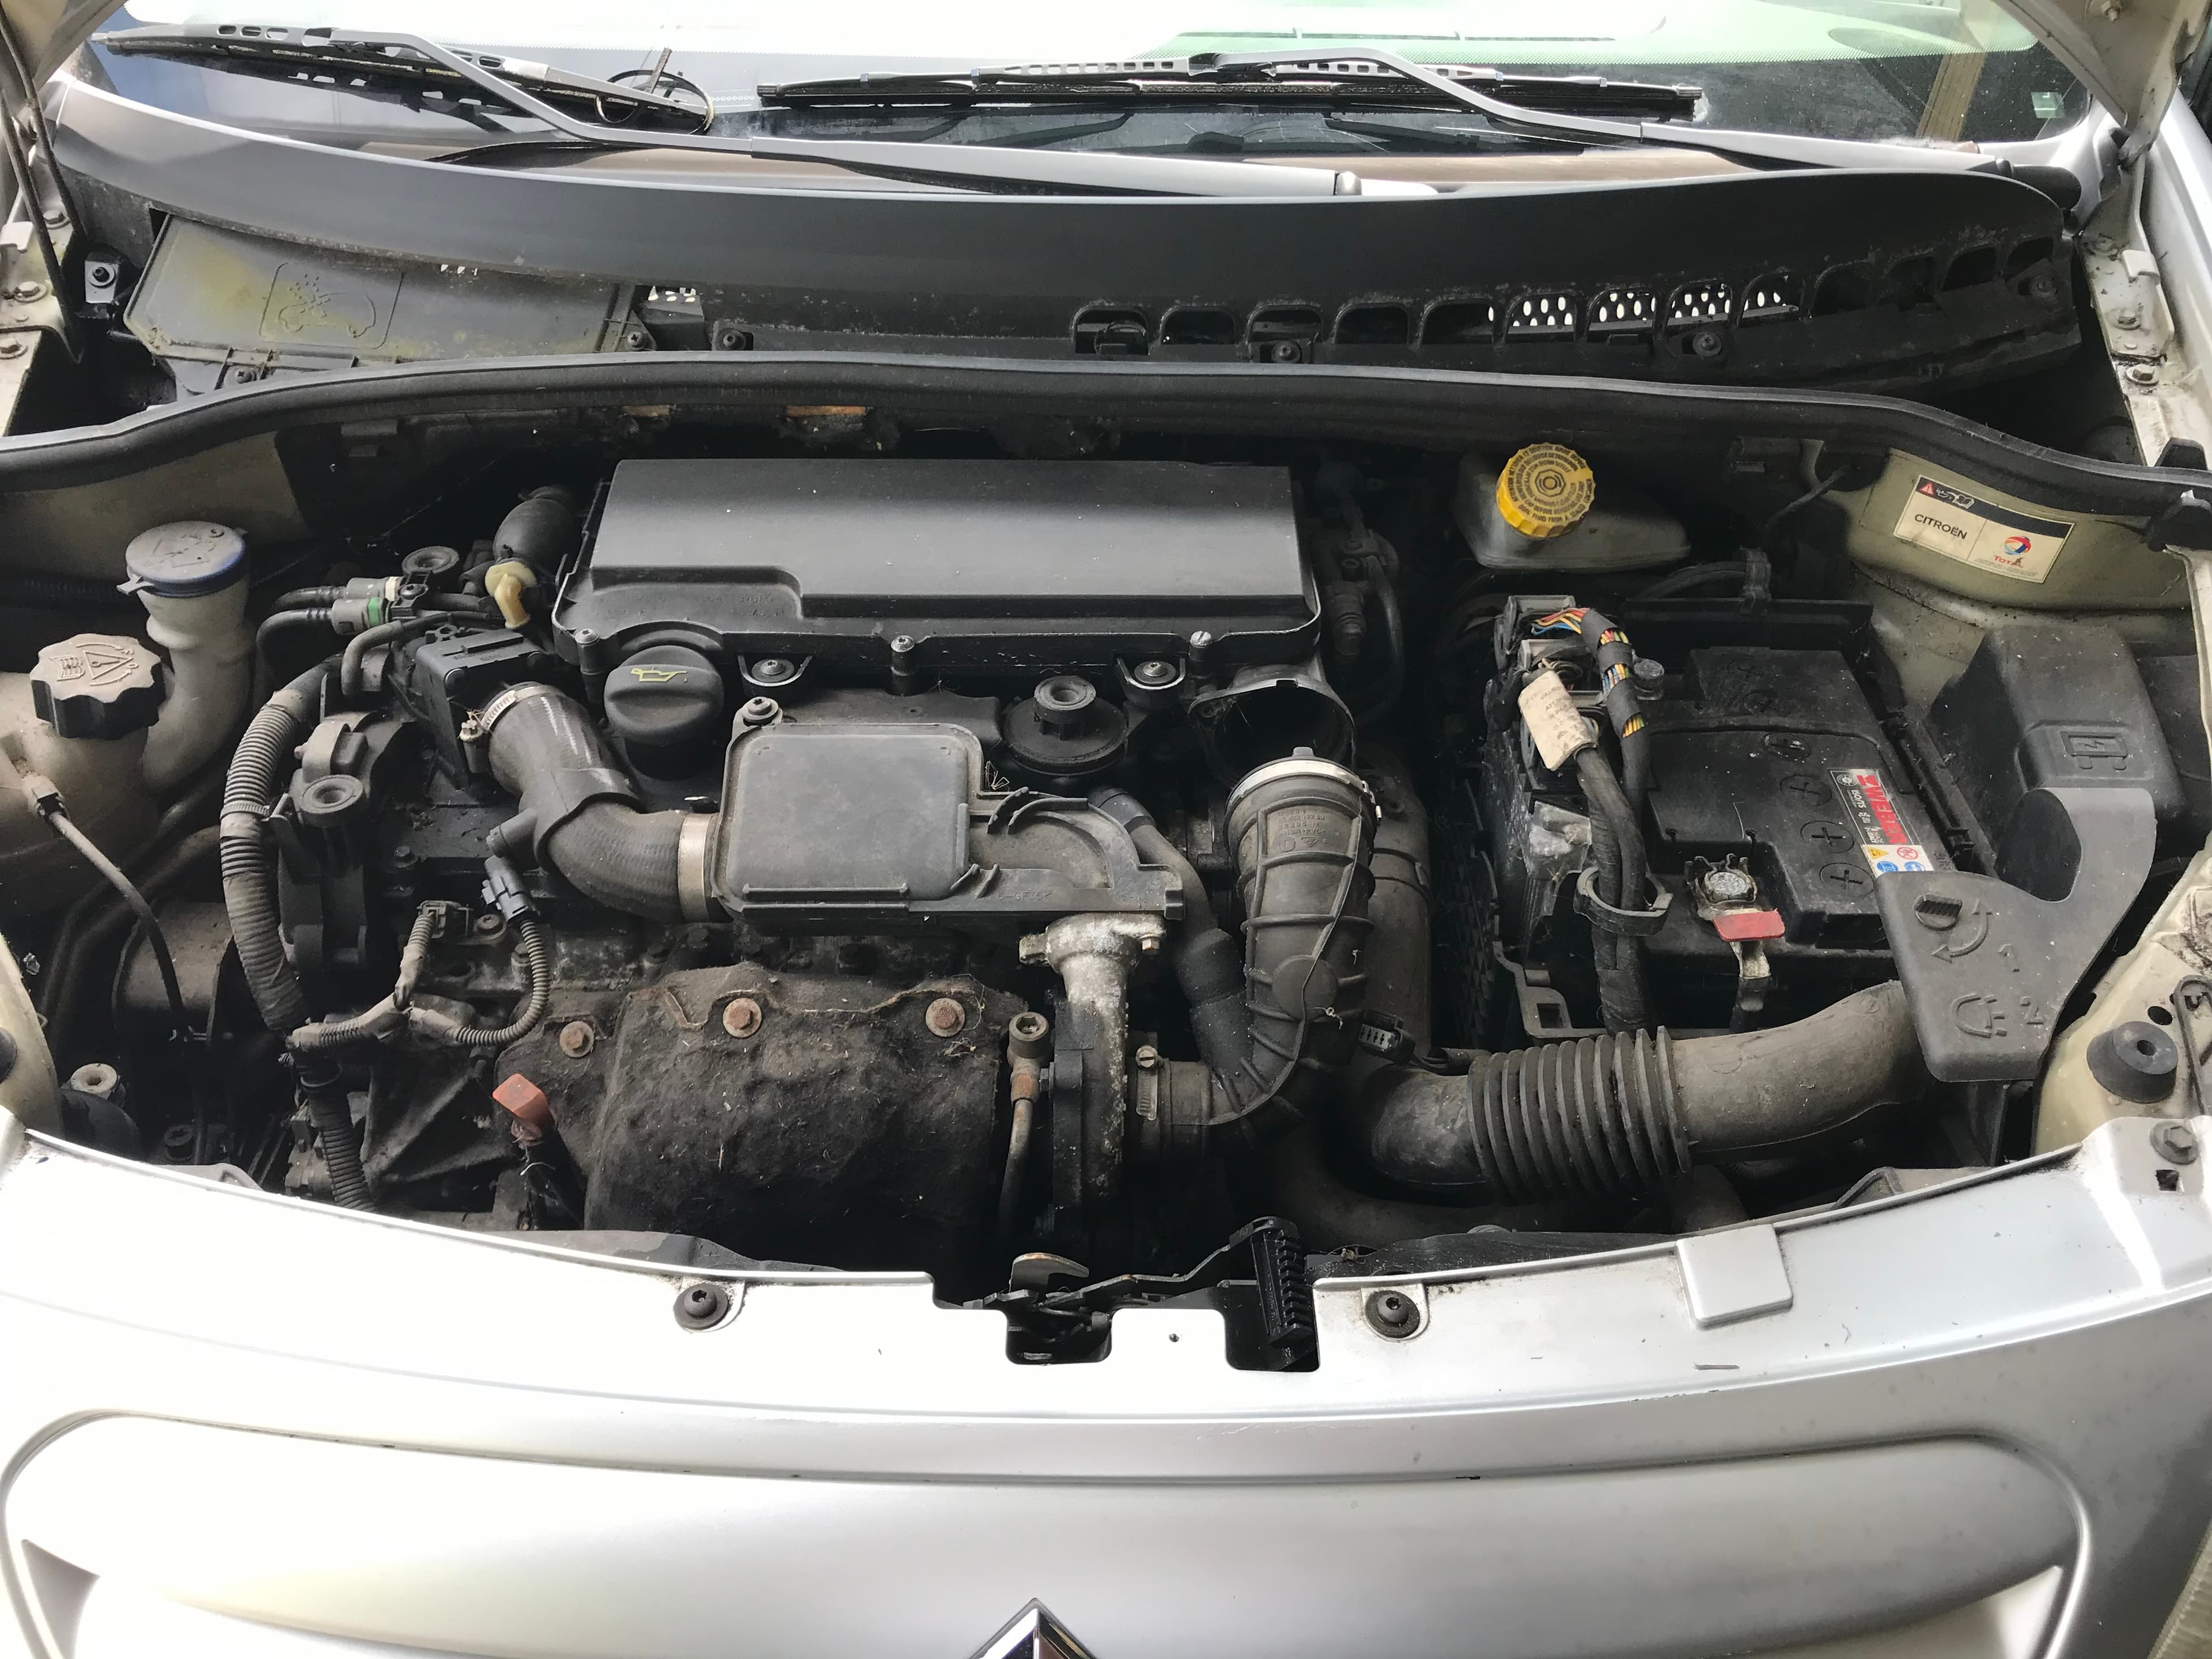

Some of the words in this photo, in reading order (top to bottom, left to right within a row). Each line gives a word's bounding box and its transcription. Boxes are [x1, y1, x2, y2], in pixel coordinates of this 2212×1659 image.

[1914, 513, 1967, 540] CITROËN
[1994, 555, 2024, 568] TOTAL
[1864, 787, 1907, 844] WEBER
[2019, 995, 2044, 1025] 2
